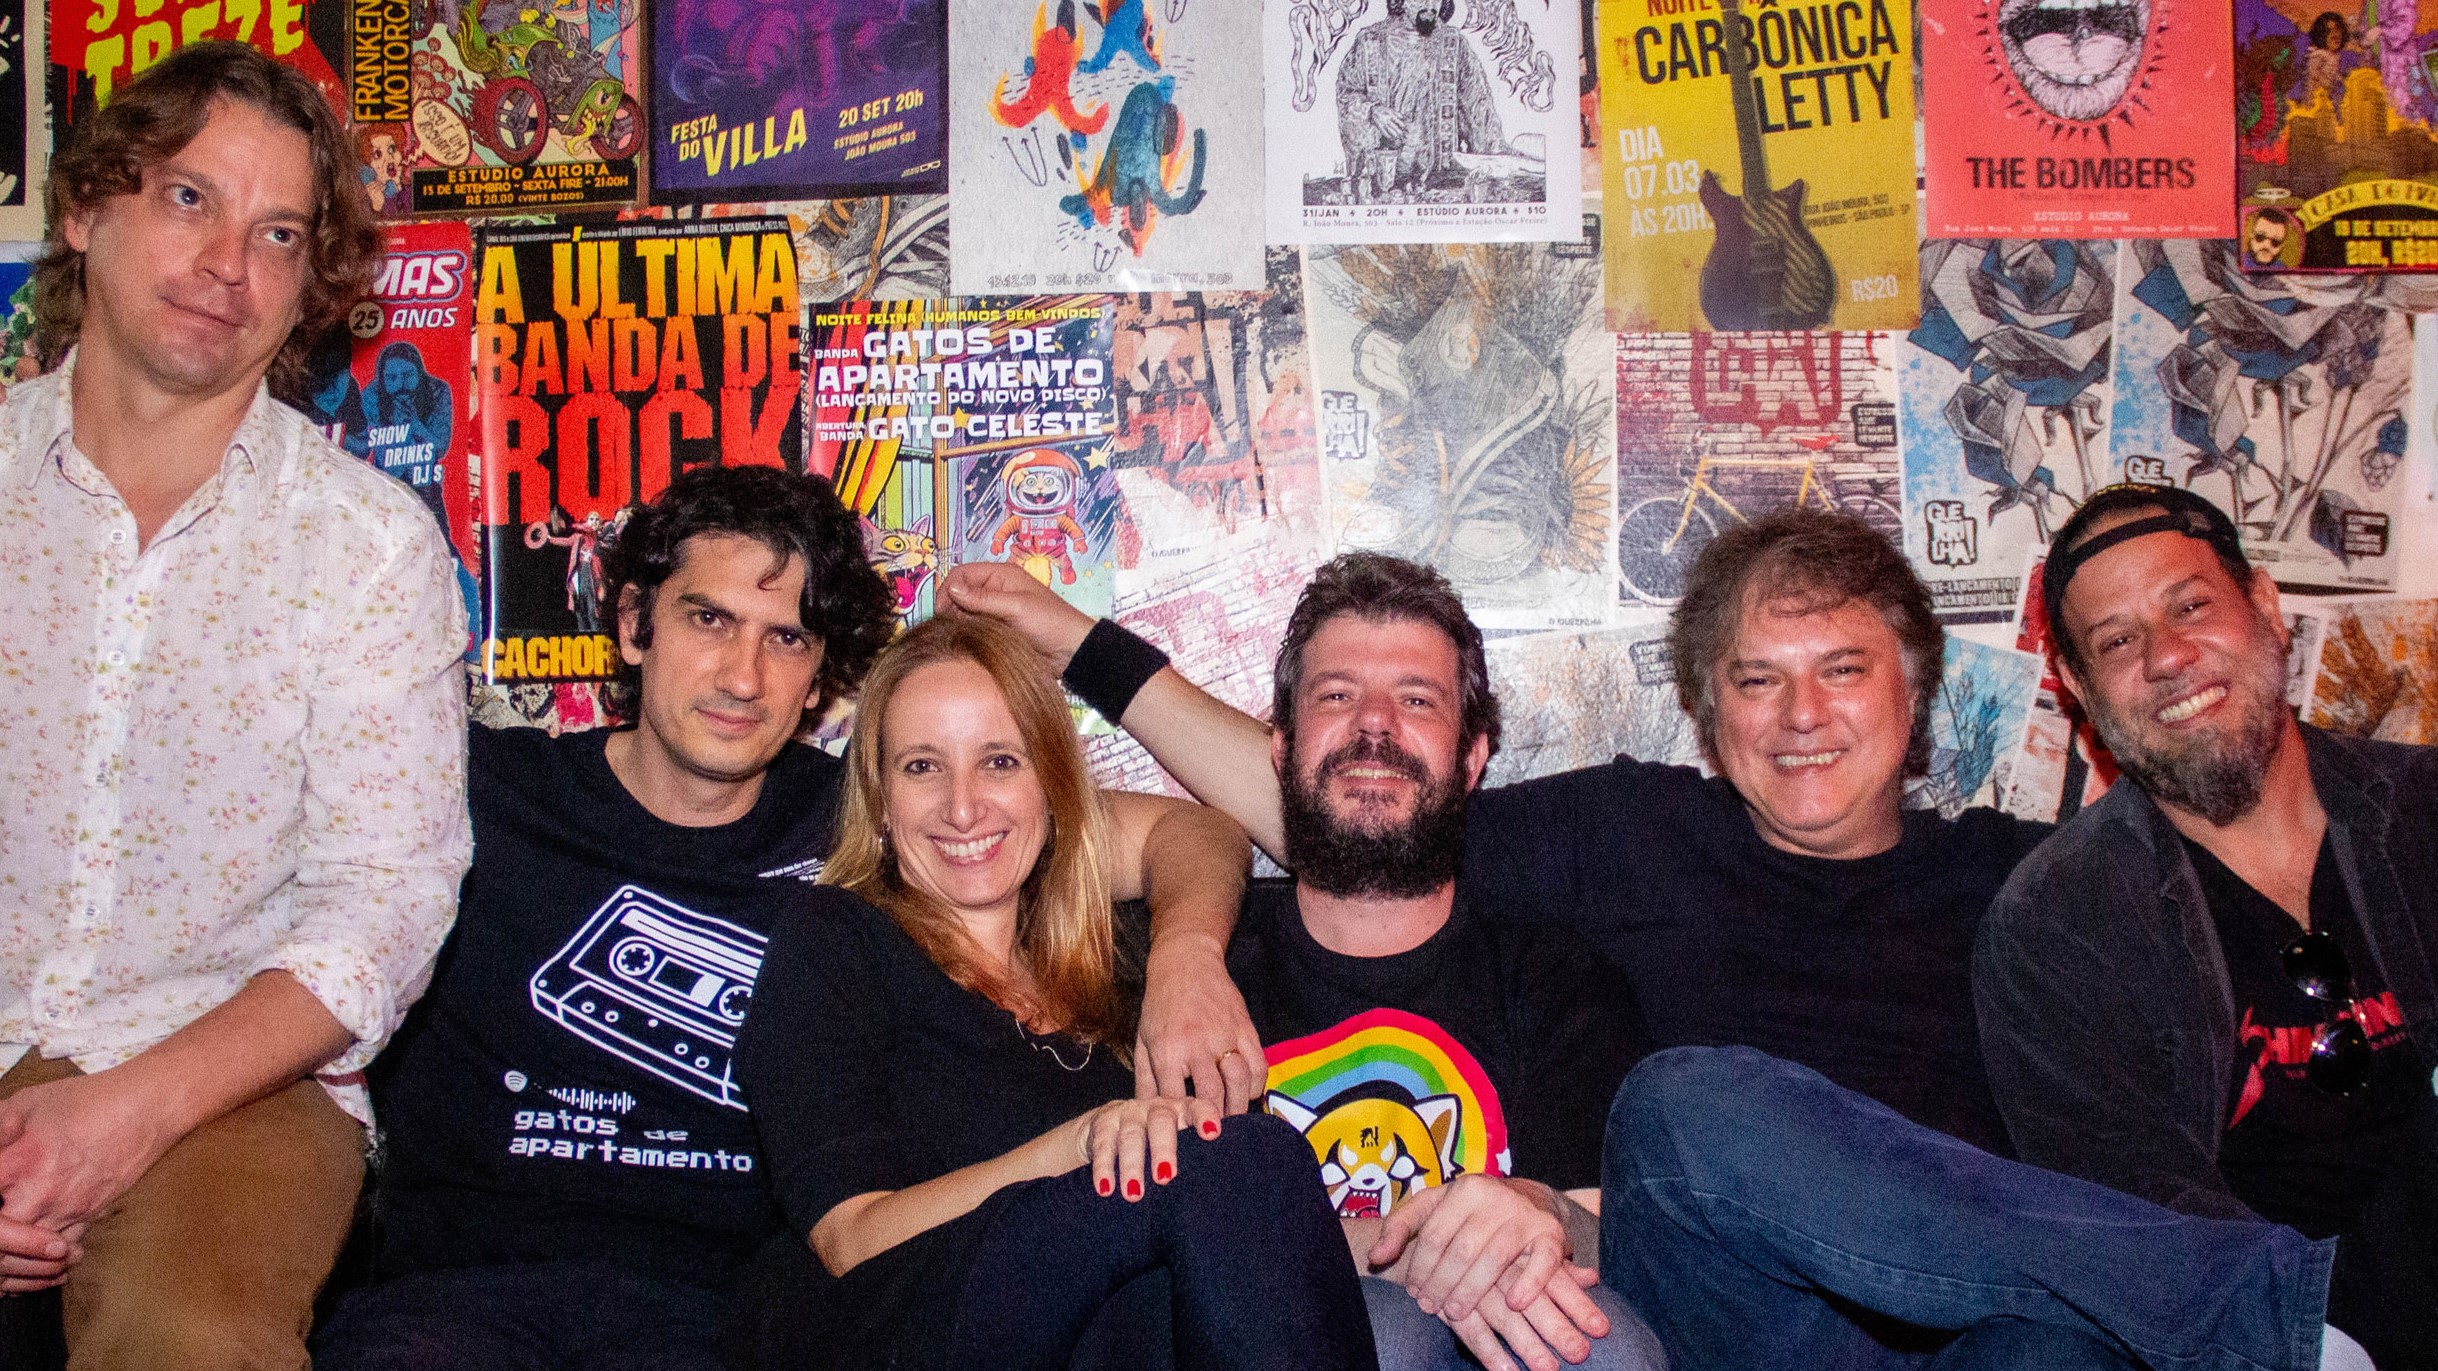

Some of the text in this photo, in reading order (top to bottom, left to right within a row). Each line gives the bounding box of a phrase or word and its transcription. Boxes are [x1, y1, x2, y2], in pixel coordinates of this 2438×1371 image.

[1634, 0, 1900, 85] CARBÔNICA
[383, 0, 410, 121] MOTORC
[838, 88, 924, 129] 20 SET 20h
[1753, 61, 1892, 134] LETTY
[671, 113, 718, 145] FESTA
[678, 108, 808, 177] DO VILLA
[1619, 126, 1665, 163] DIA
[533, 163, 610, 180] AURORA
[1624, 159, 1701, 200] 07.03
[1966, 157, 2197, 189] THE BOMBERS
[437, 184, 451, 196] DE
[454, 182, 512, 195] SETEMBRO
[522, 180, 557, 192] SEXTA
[1366, 208, 1388, 217] 20H
[1465, 206, 1508, 216] AURORA
[1528, 206, 1547, 215] $10
[1630, 204, 1658, 238] ÀS
[476, 226, 799, 324] A ÚLTIMA
[1852, 274, 1899, 302] R$20
[352, 309, 380, 331] 25
[390, 307, 459, 330] ANOS
[815, 313, 864, 327] NOITE
[866, 312, 916, 326] FELINA
[476, 311, 801, 396] BANDA DE
[814, 326, 1056, 360] BANDA GATOS DE
[818, 358, 1105, 392] APARTAMENTO
[815, 386, 1107, 410] (LANÇAMENTO DO NOVO DISCO)
[368, 423, 410, 448] SHOW
[816, 421, 866, 431] ABERTURA
[819, 411, 1103, 442] BANDA GATO CELESTE
[384, 442, 434, 468] DRINKS
[480, 385, 800, 526] ROCK
[514, 1109, 689, 1141] gatos de
[509, 1137, 752, 1173] apartamento
